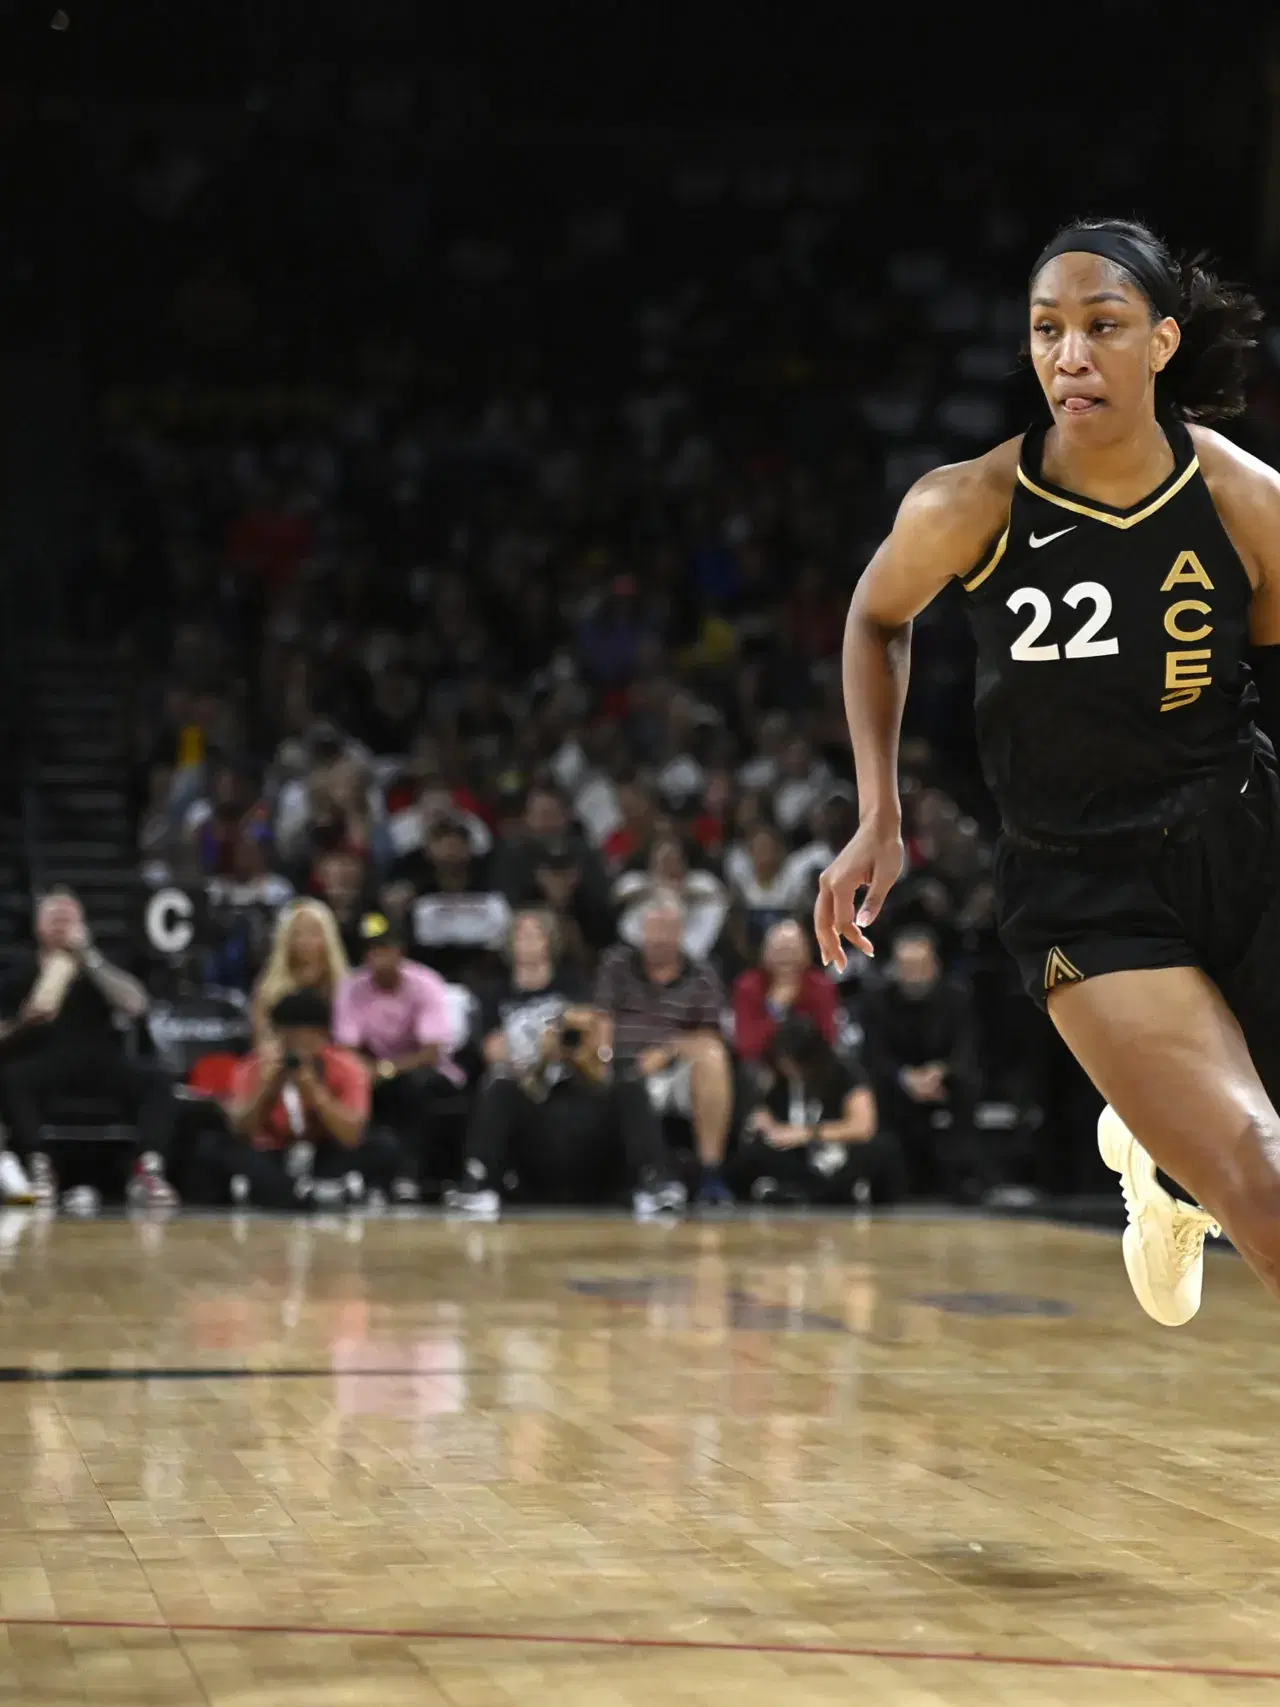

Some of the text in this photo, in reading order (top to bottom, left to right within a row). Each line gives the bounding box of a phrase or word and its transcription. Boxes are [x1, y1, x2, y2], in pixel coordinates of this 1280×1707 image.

[1006, 581, 1119, 661] 22
[1160, 551, 1215, 712] ACES
[147, 888, 194, 952] C
